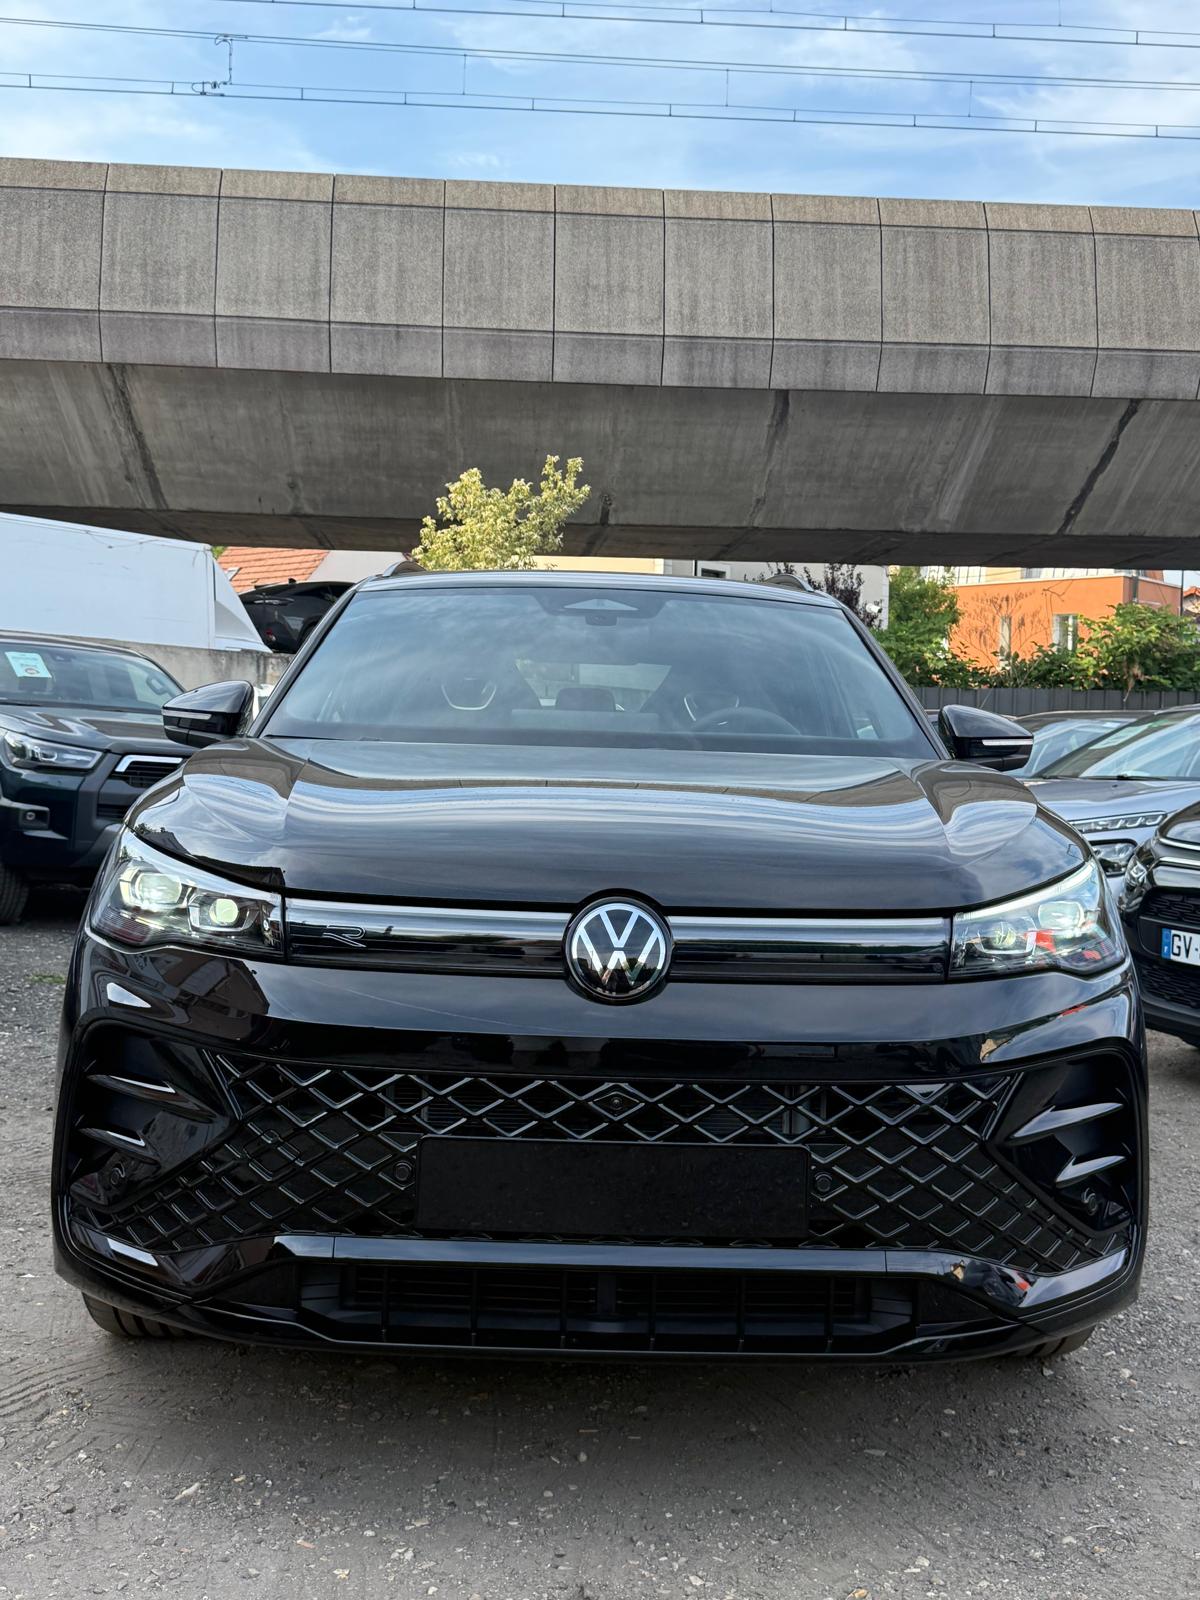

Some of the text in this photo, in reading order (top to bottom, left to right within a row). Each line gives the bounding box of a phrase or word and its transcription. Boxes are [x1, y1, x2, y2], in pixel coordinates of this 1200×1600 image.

[321, 924, 367, 948] R
[575, 905, 663, 989] VW
[1171, 933, 1200, 959] GV-
